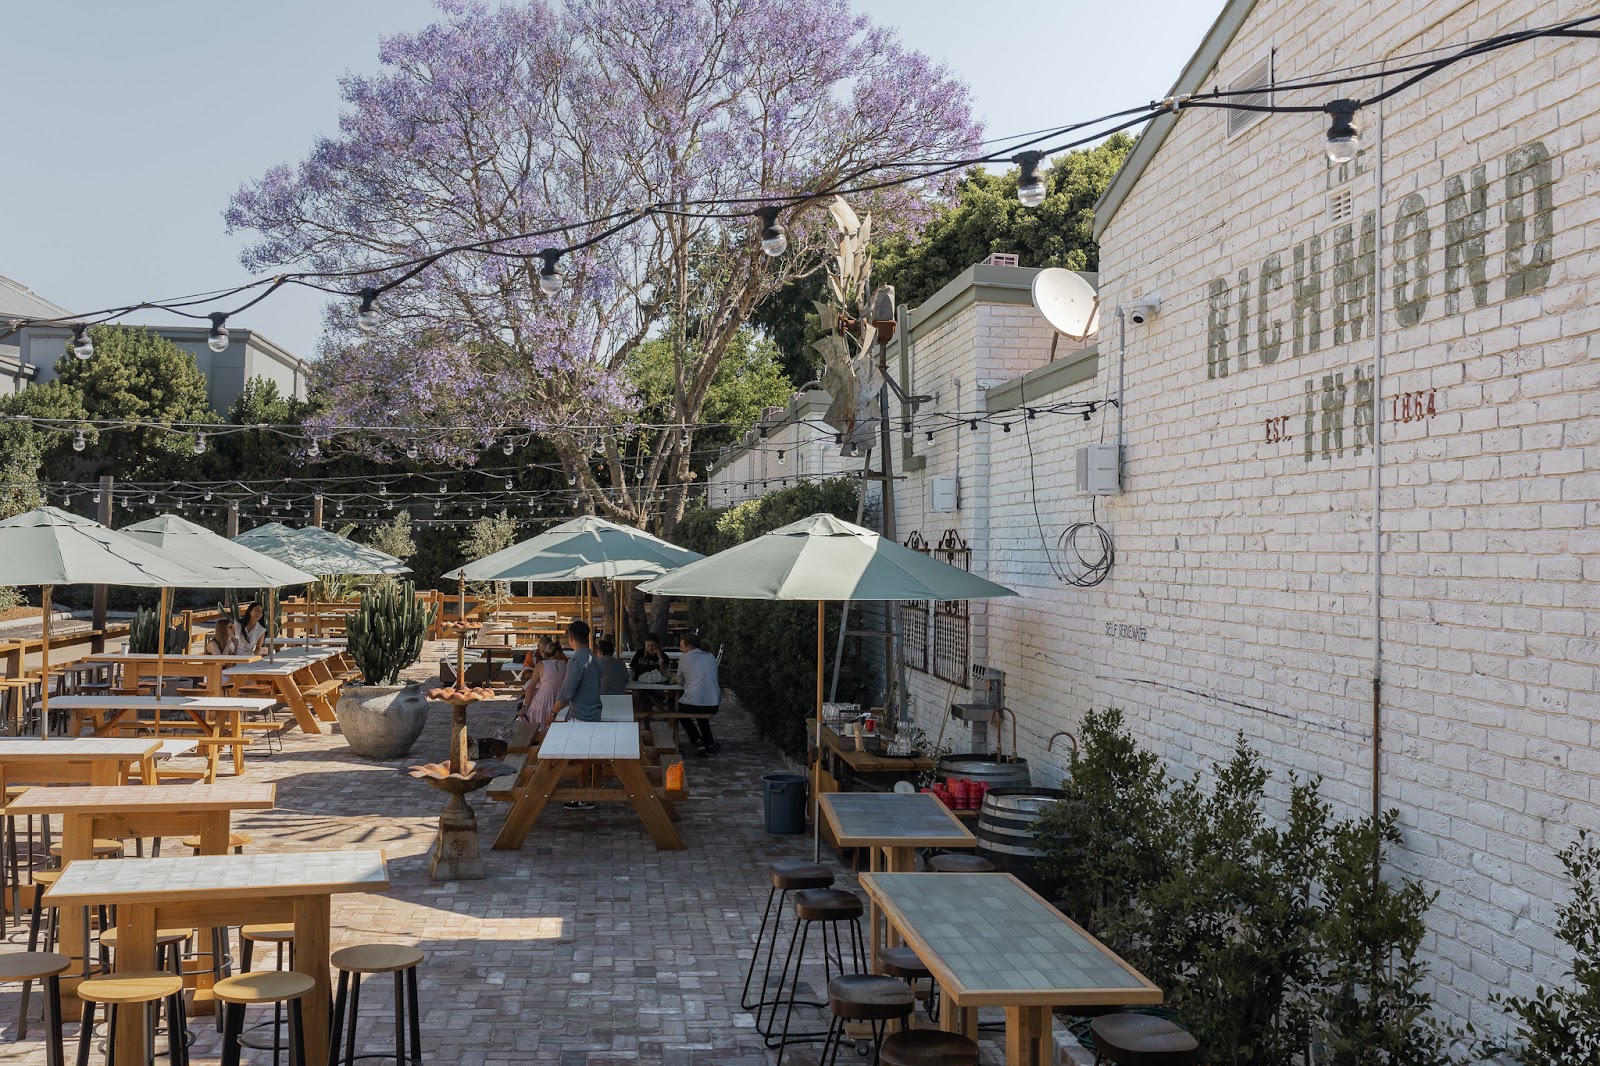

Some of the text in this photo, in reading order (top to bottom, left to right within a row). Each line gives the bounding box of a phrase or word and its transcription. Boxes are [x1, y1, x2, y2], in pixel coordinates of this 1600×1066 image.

[1207, 141, 1553, 380] RICHMOND
[1305, 364, 1376, 462] INN
[1392, 388, 1437, 423] 1864
[1105, 622, 1148, 642] SELF SERVE WATER
